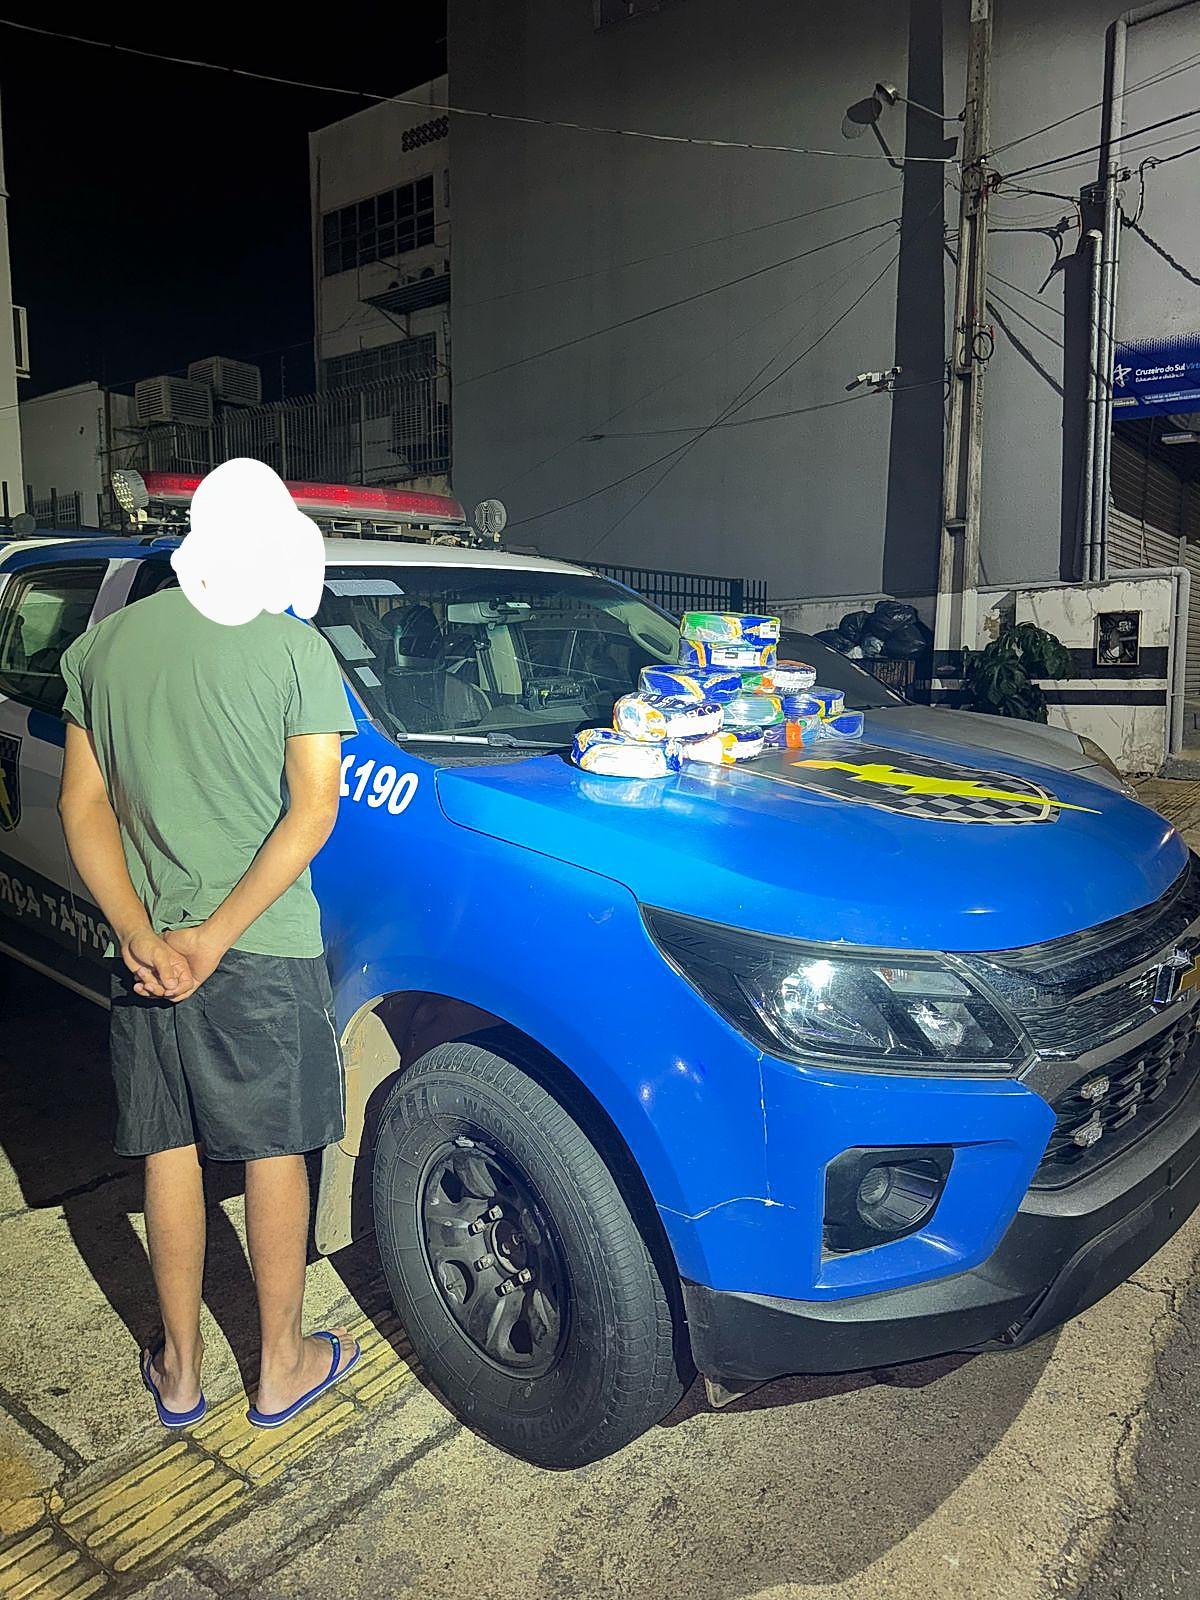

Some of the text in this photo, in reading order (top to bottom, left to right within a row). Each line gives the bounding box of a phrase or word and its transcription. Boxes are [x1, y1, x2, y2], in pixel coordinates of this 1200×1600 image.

[1135, 367, 1164, 376] Cruzeiro
[1165, 365, 1174, 373] do
[1175, 363, 1185, 371] Sul
[353, 759, 419, 815] 190
